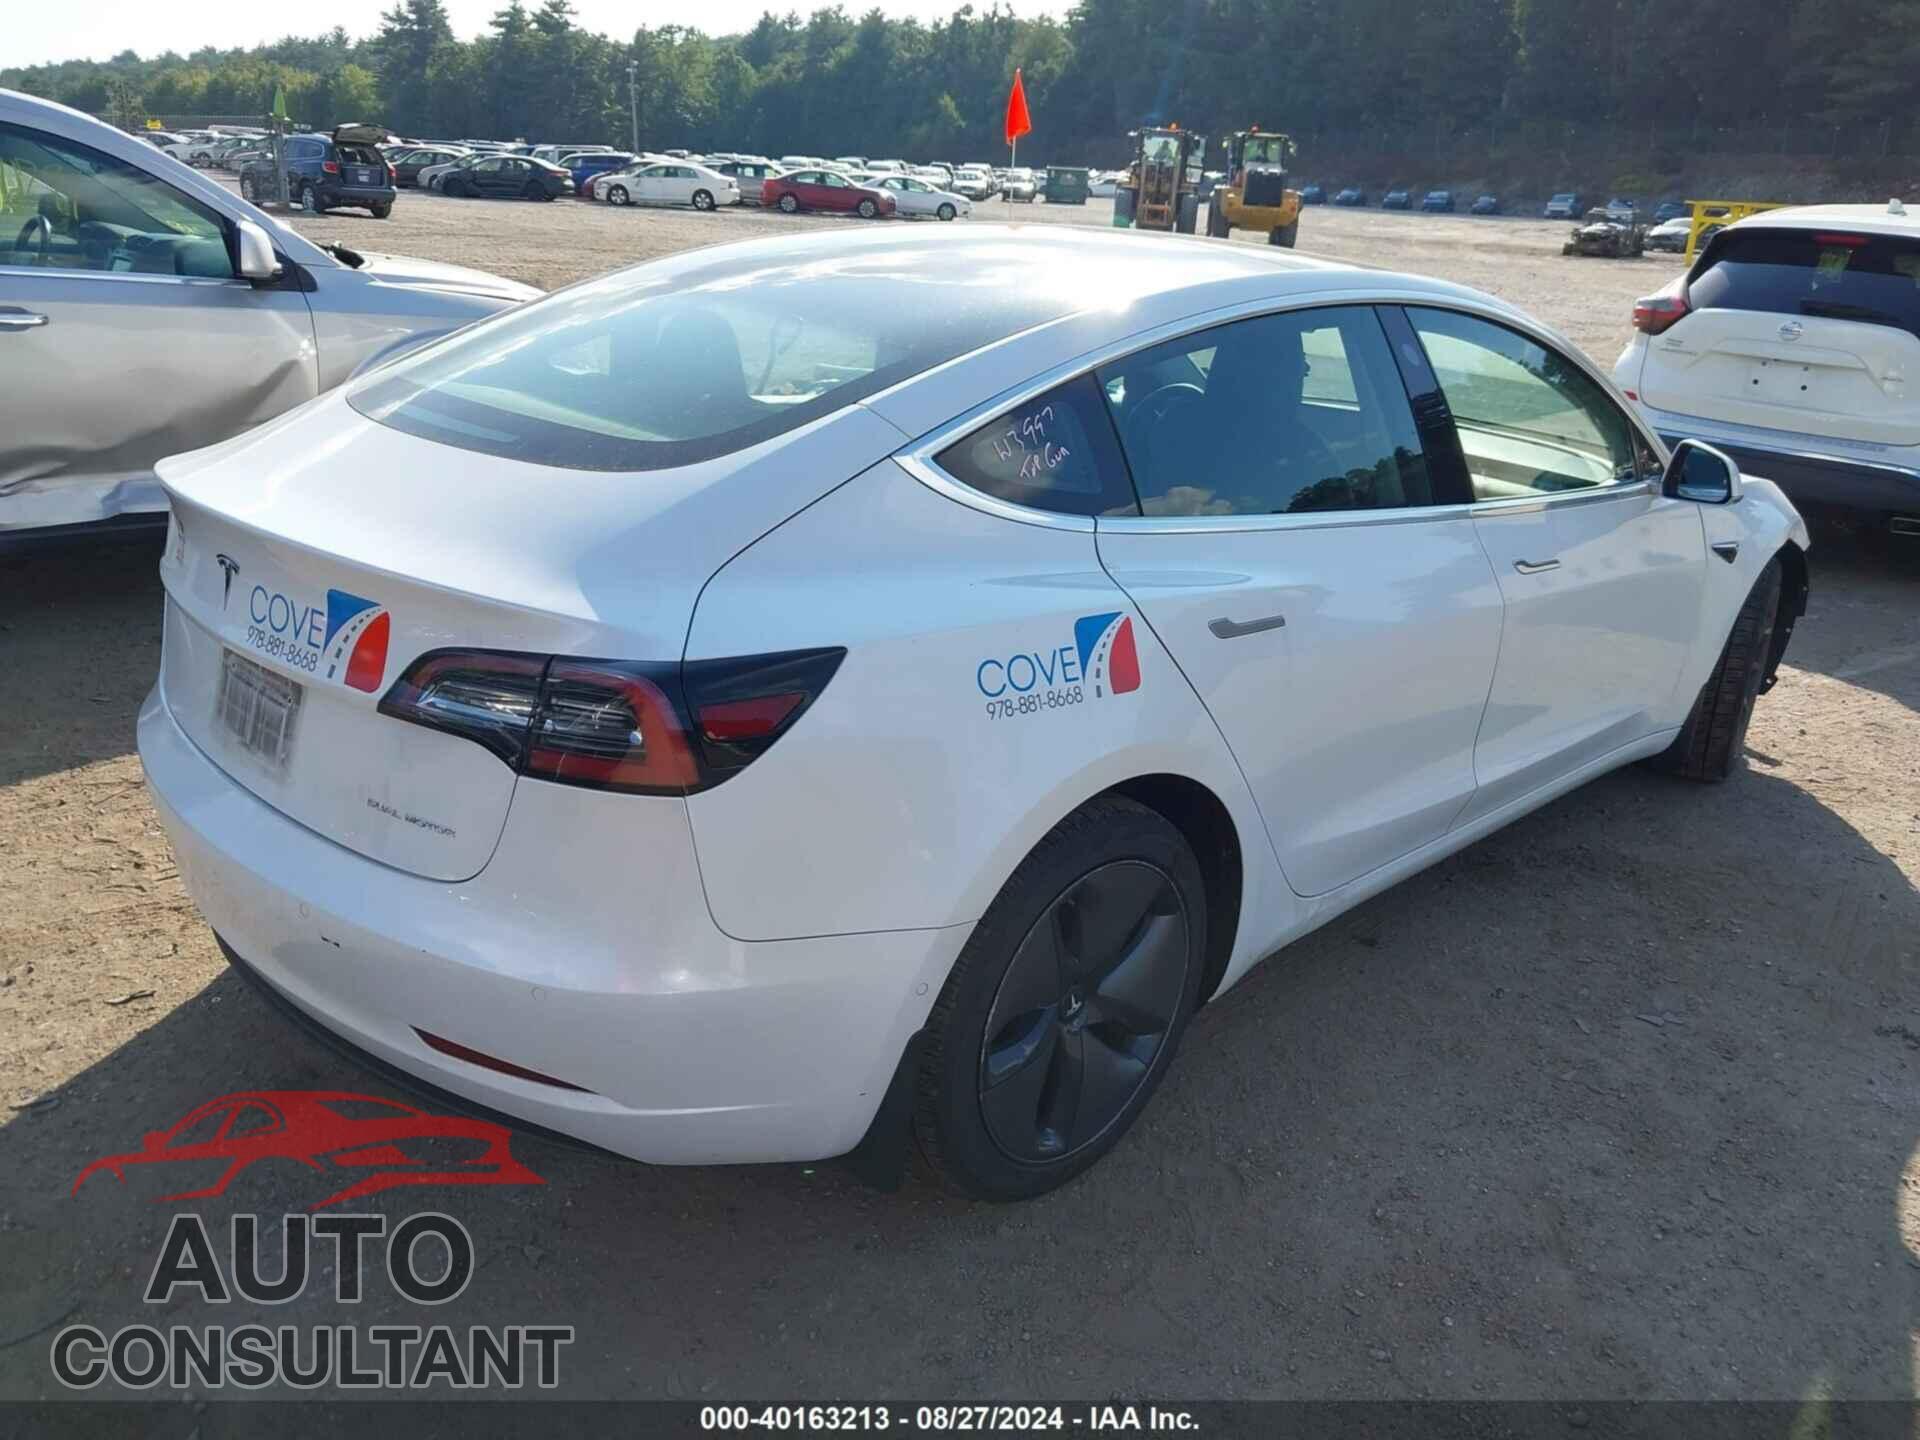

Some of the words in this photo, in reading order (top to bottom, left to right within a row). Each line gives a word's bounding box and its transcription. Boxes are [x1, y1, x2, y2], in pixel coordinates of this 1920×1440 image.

[250, 585, 325, 649] COVE
[246, 625, 319, 673] 978-881-8668
[977, 646, 1080, 698] COVE
[986, 685, 1084, 720] 978-881-8668
